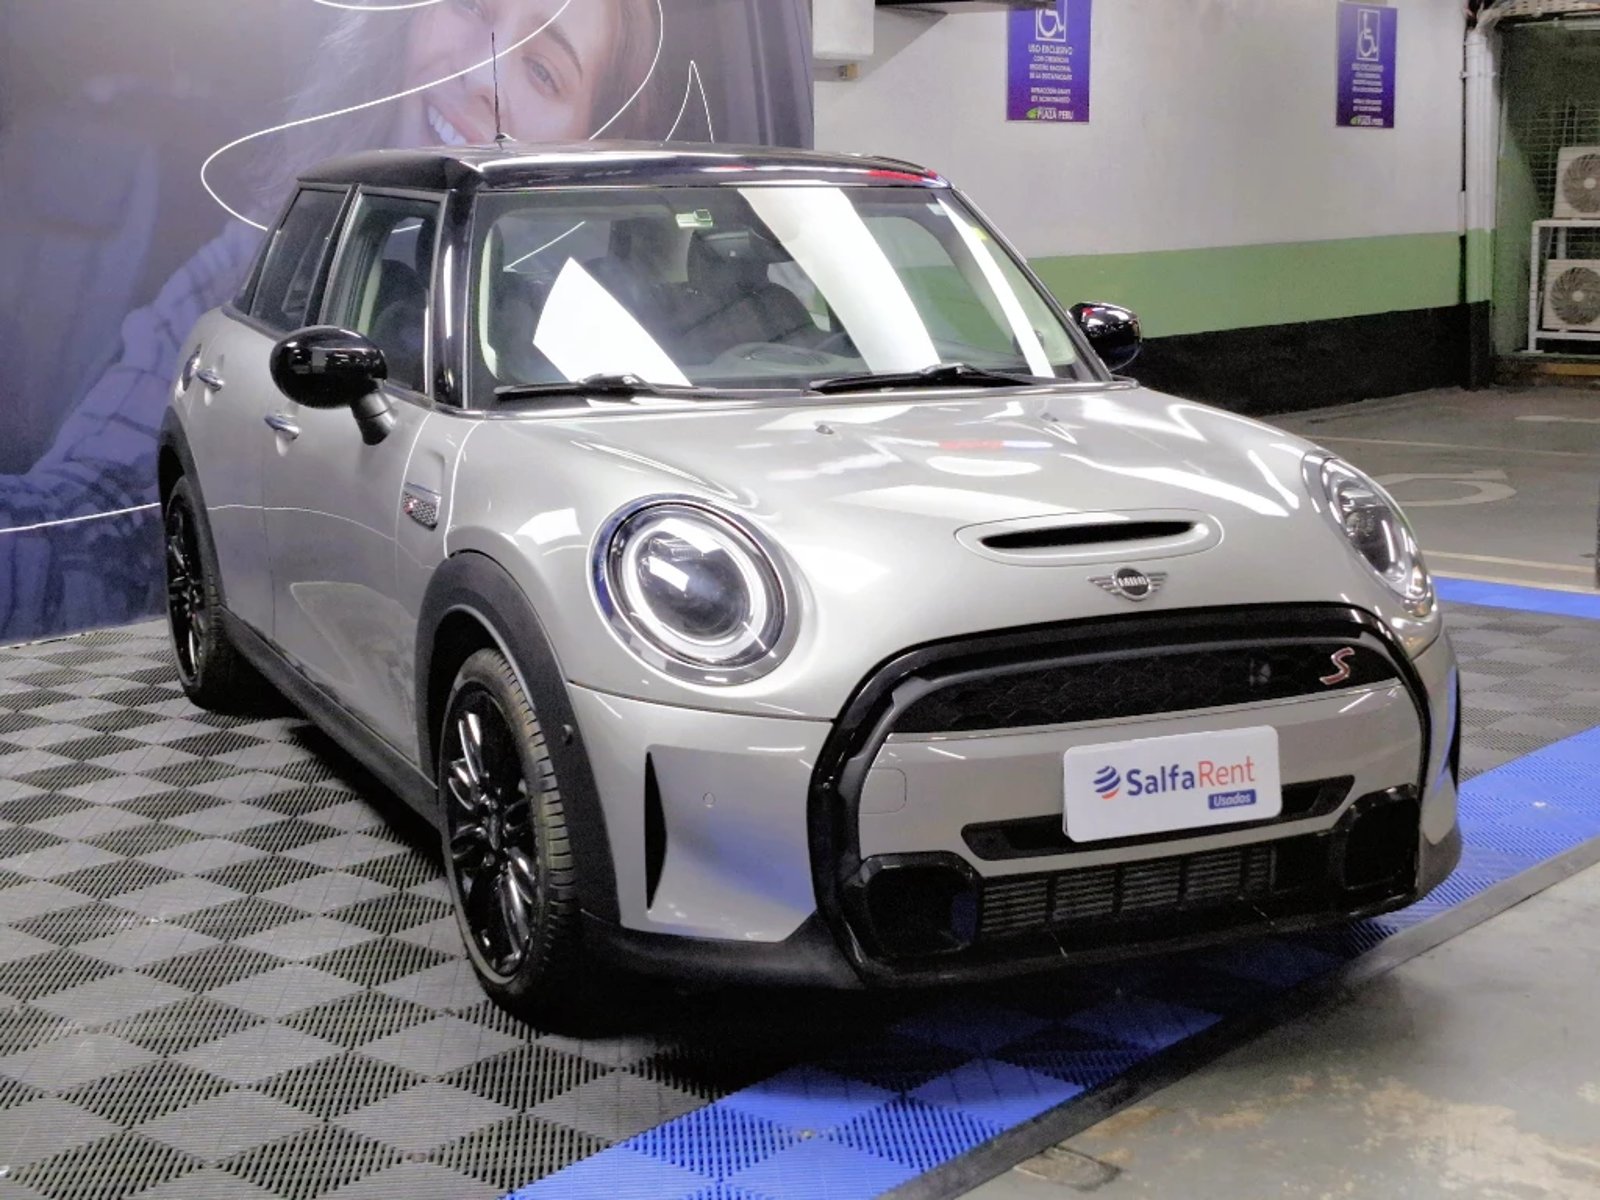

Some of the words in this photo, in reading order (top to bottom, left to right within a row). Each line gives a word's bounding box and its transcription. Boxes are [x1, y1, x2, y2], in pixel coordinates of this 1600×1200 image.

[1037, 109, 1057, 119] PLAZA
[1319, 647, 1355, 685] S
[1213, 792, 1251, 807] Usados
